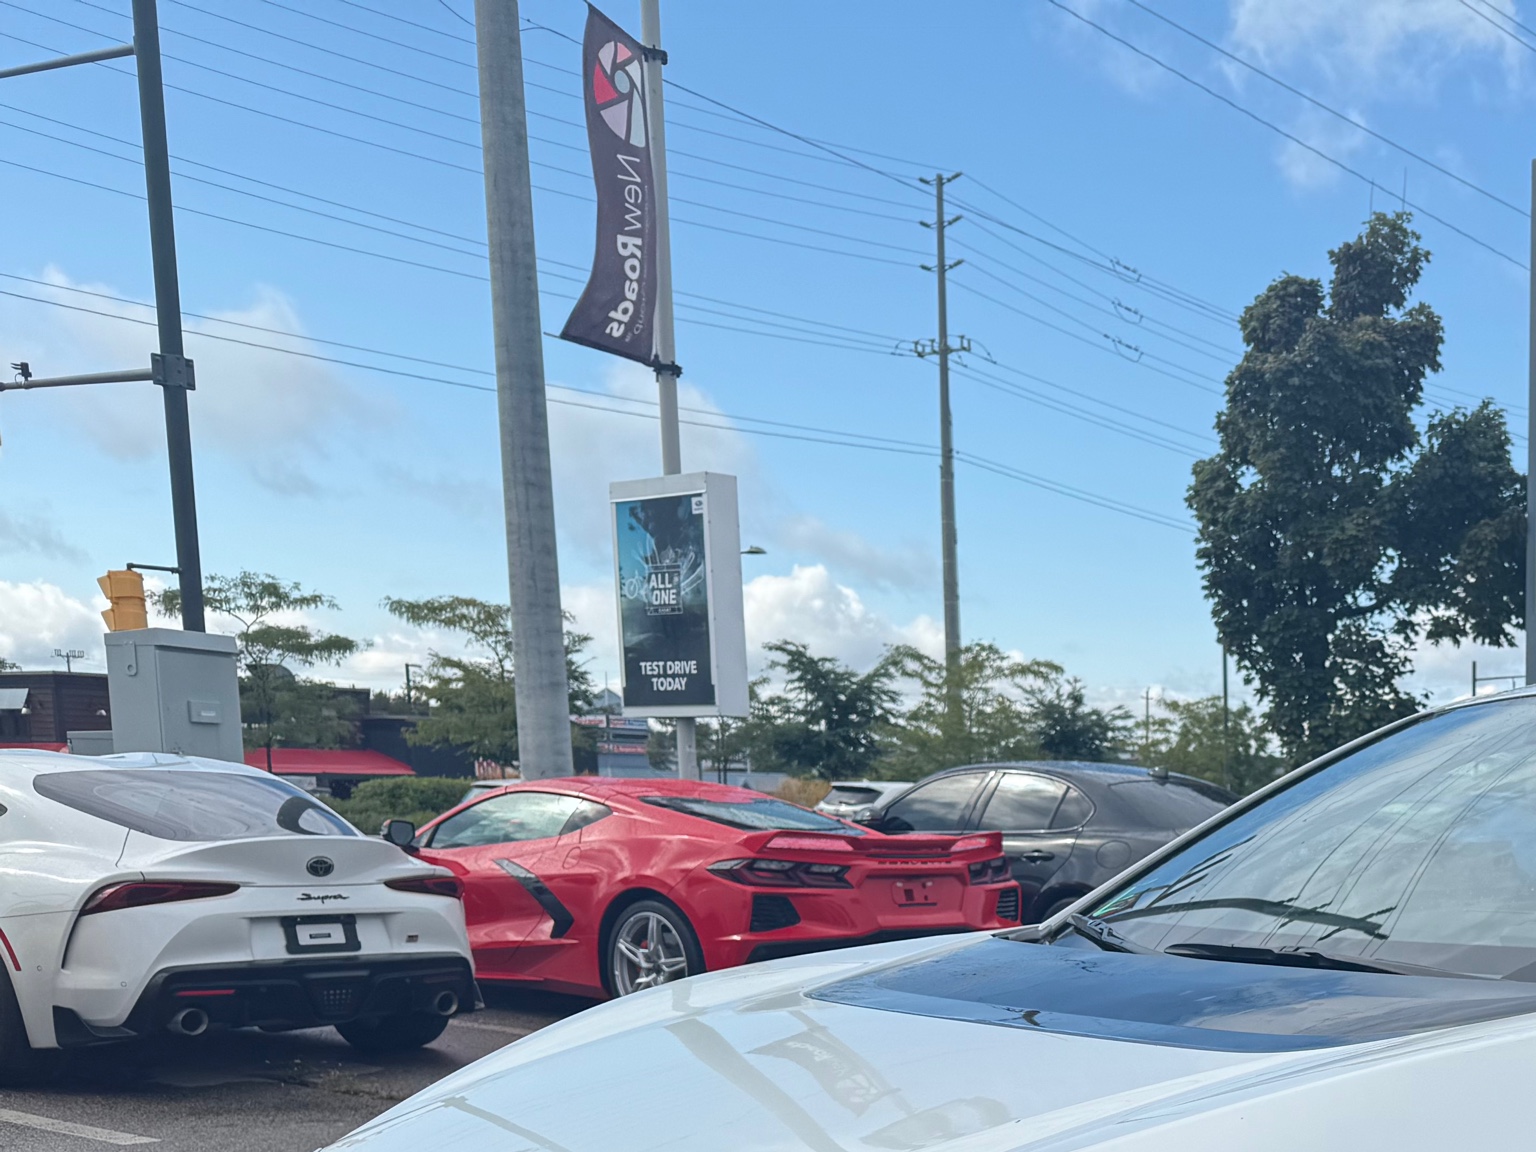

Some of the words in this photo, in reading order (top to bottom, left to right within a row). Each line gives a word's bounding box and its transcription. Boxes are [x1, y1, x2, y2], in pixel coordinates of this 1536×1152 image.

[650, 573, 672, 589] ALL
[653, 589, 677, 605] ONE
[639, 661, 665, 676] TEST
[666, 660, 697, 675] DRIVE
[651, 677, 687, 692] TODAY
[297, 893, 349, 904] Supra
